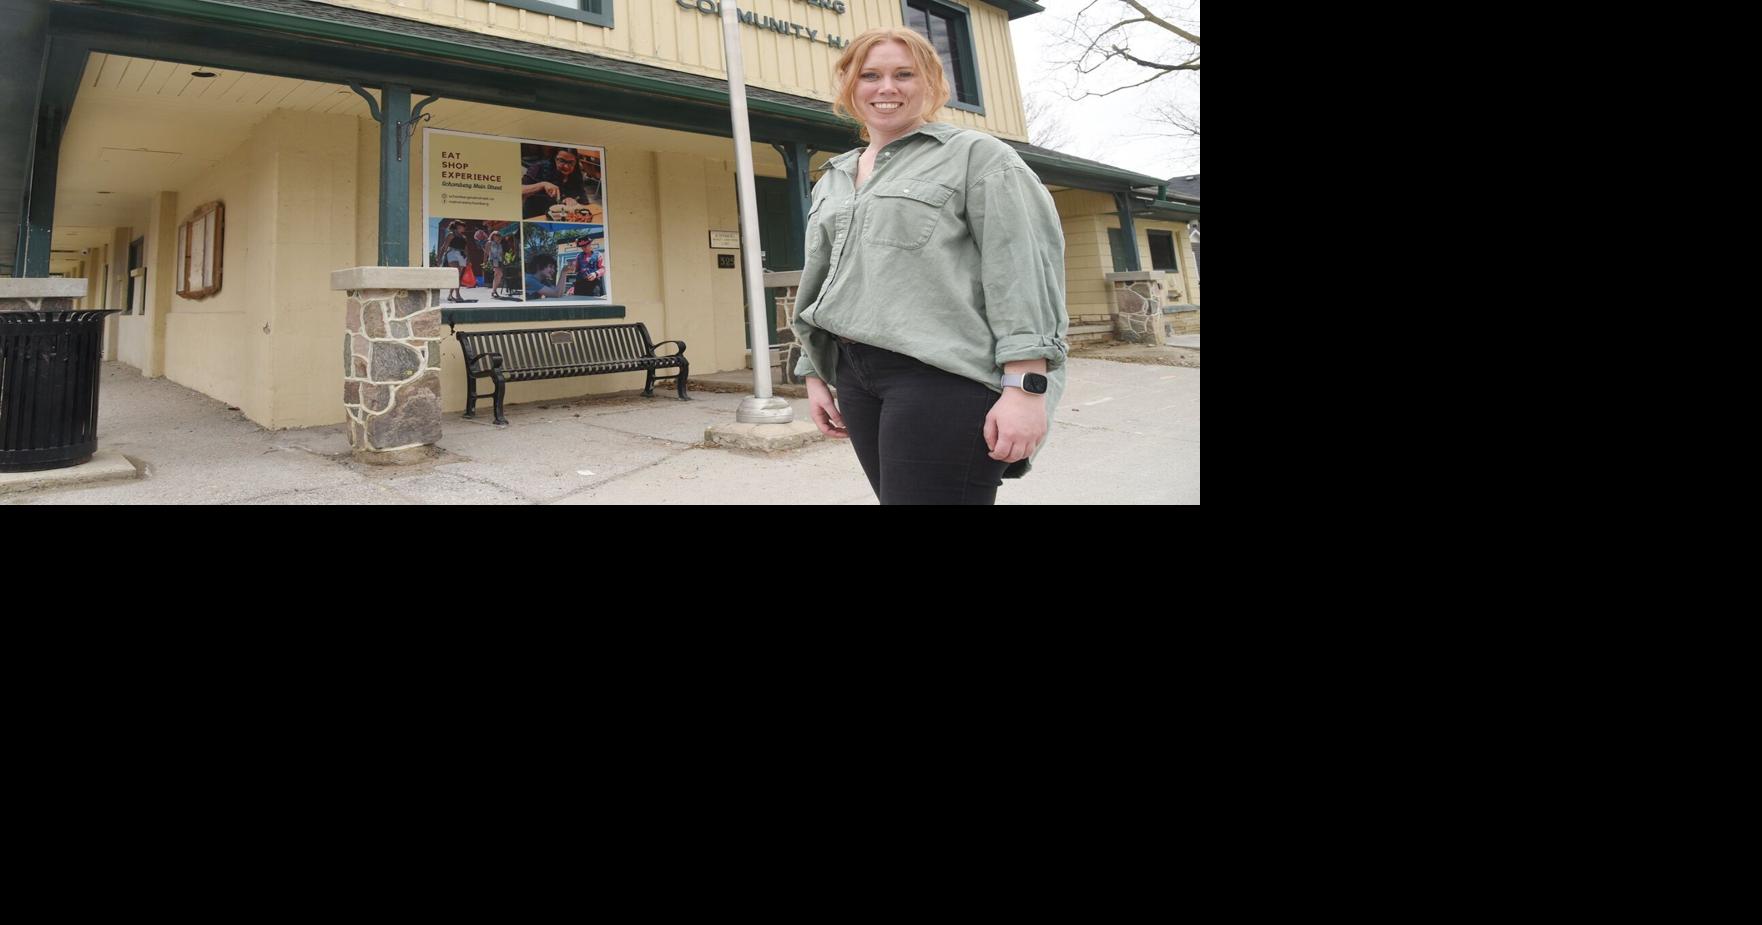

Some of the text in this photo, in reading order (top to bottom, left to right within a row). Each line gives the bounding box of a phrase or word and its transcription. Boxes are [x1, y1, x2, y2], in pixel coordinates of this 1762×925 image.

[675, 0, 818, 43] COMUNITY
[442, 151, 460, 159] EAT
[442, 161, 469, 170] SHOP
[441, 171, 502, 182] EXPERIENCE
